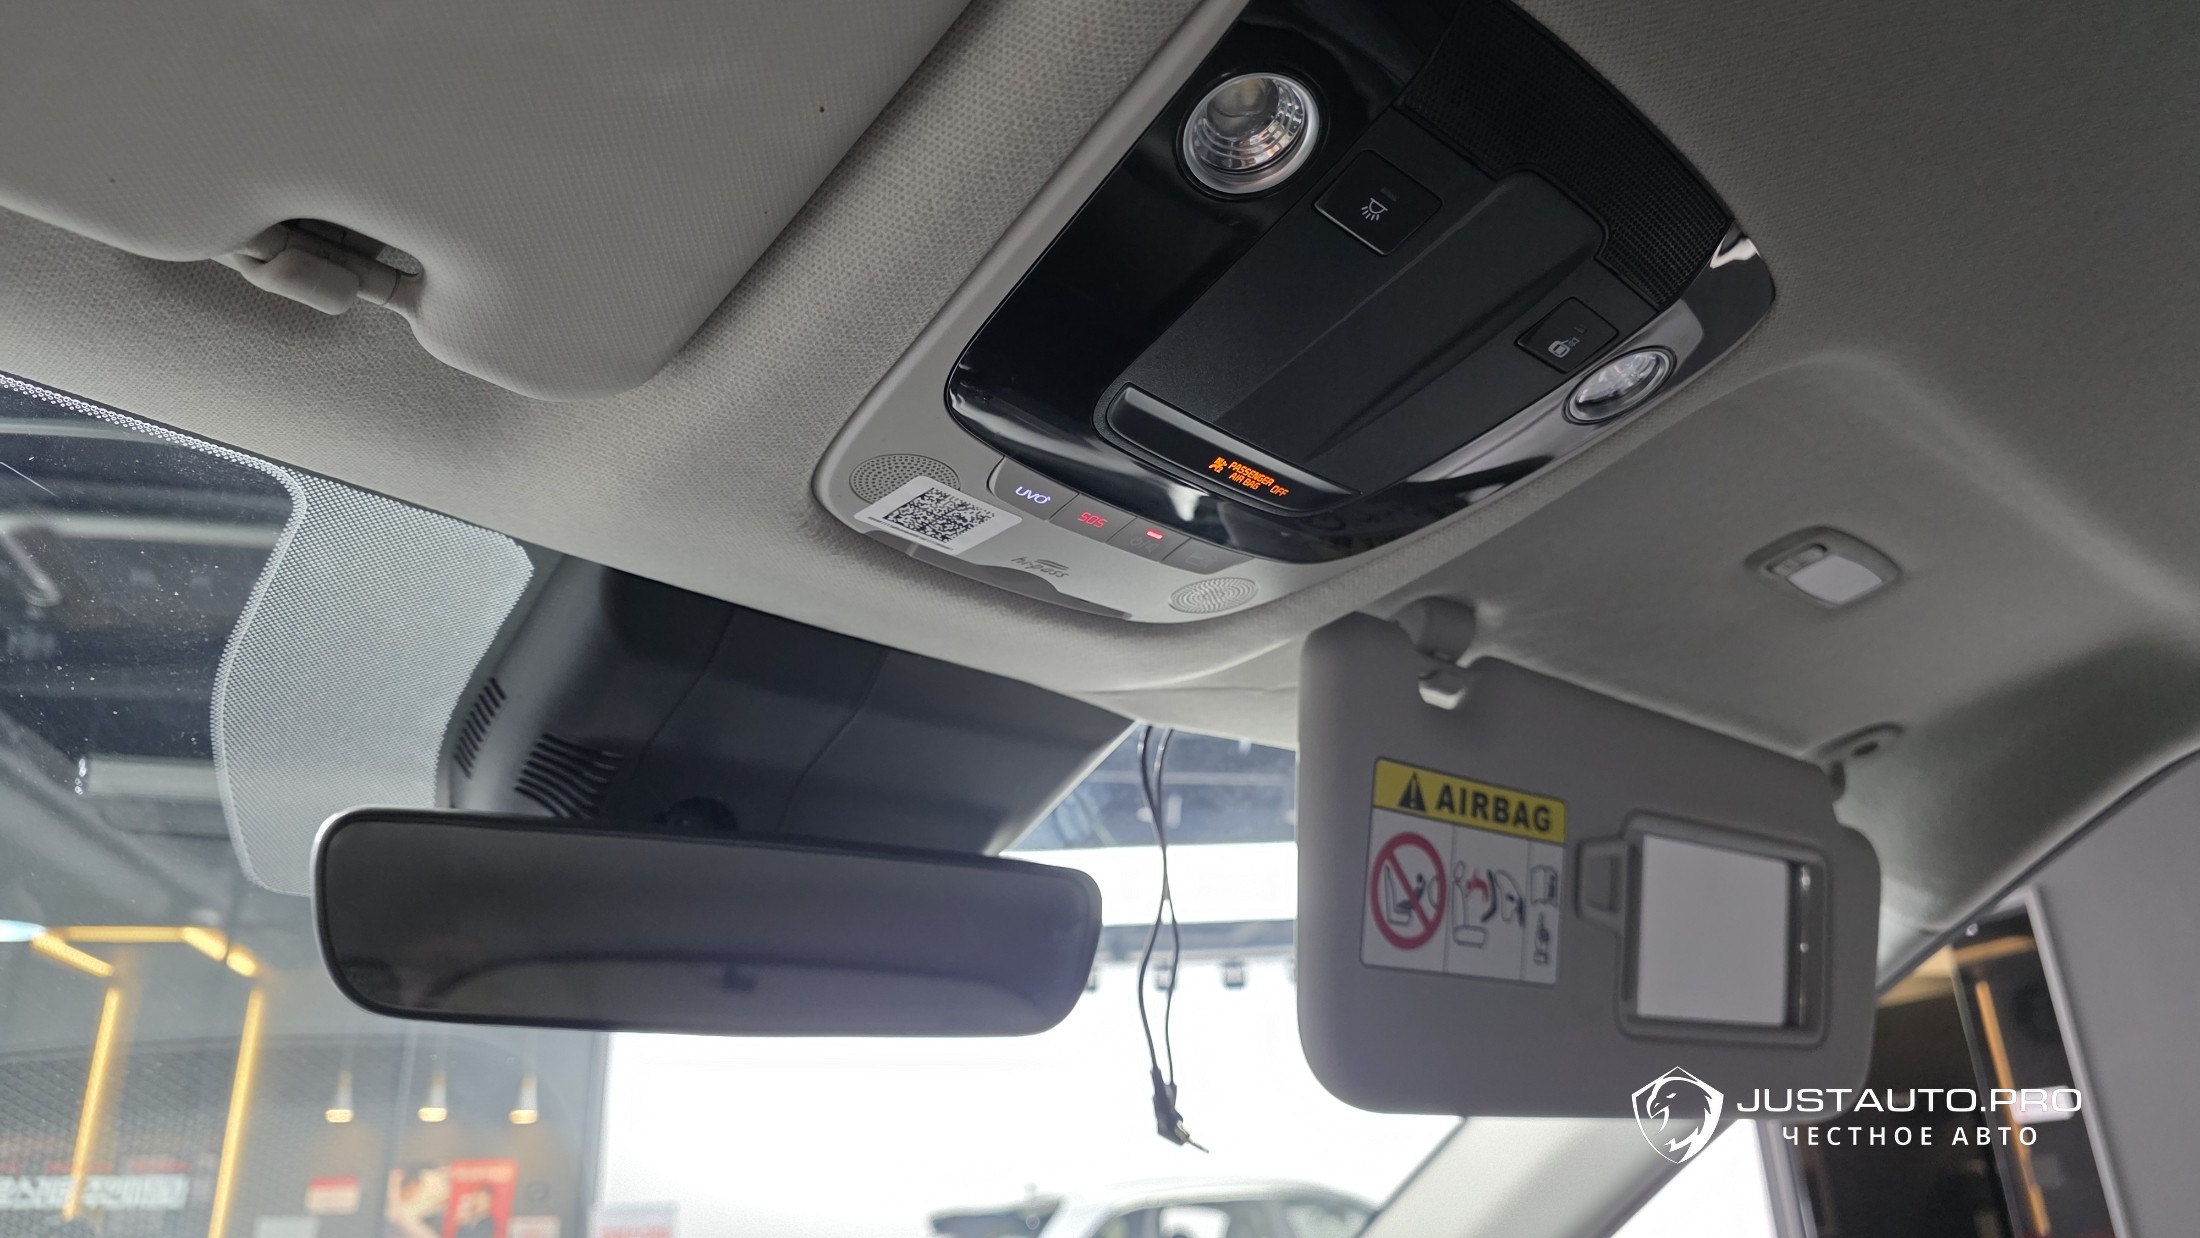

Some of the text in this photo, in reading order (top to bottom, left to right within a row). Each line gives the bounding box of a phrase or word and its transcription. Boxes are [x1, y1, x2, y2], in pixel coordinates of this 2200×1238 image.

[1228, 461, 1275, 486] PASSENGER
[1228, 472, 1261, 490] AIR BAG
[1270, 485, 1289, 496] OFF
[1078, 511, 1108, 528] SOS
[1437, 784, 1552, 832] AIRBAG
